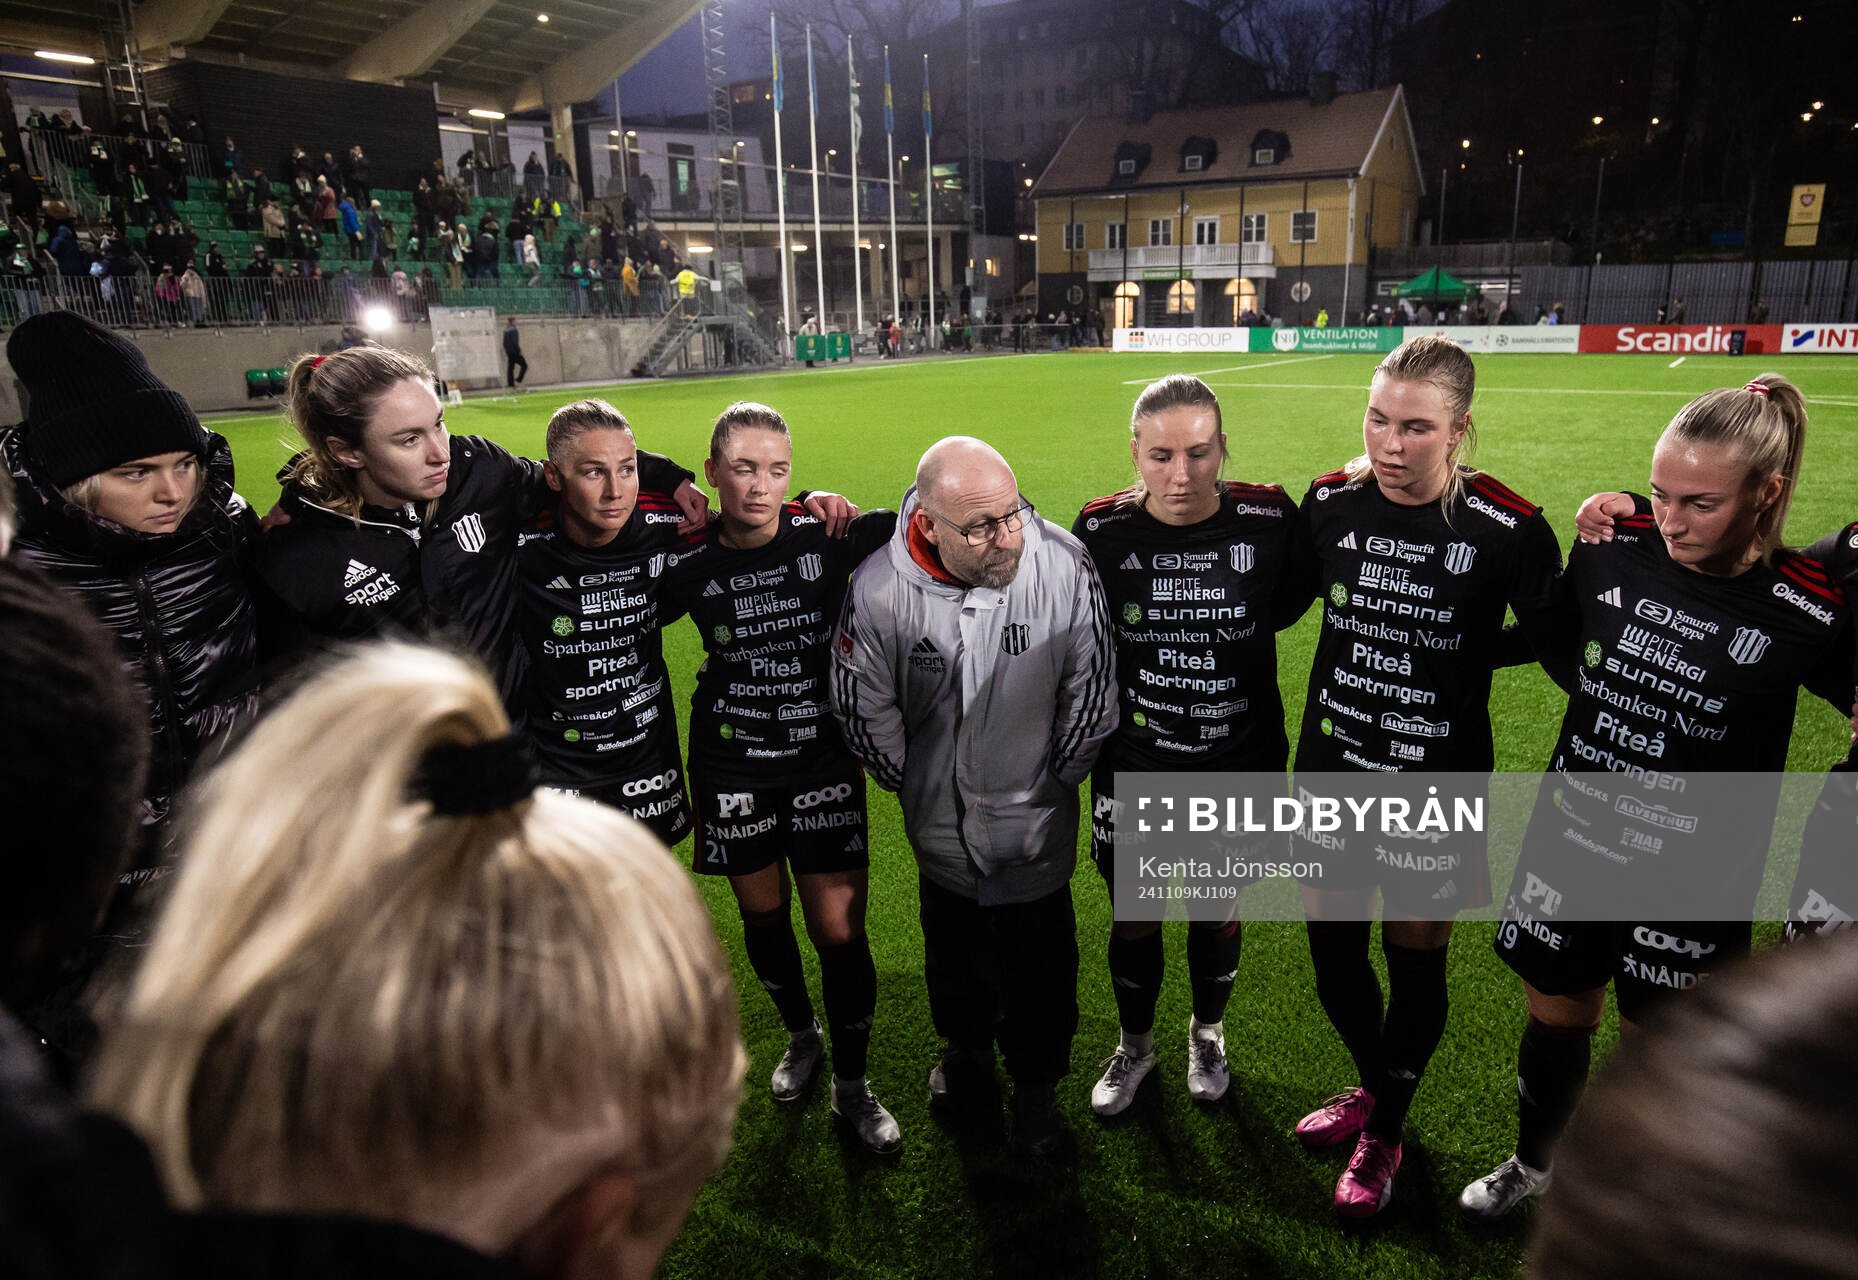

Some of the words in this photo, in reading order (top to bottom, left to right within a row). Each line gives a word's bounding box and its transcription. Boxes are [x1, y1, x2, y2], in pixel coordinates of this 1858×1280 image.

[1148, 333, 1171, 346] WH
[1176, 333, 1231, 347] GROUP
[1303, 329, 1378, 340] VENTILATION
[1616, 326, 1731, 352] Scandic
[1236, 503, 1283, 519] Picknick
[1466, 495, 1518, 530] Picknick
[1183, 552, 1219, 561] Smurfit
[1396, 549, 1426, 563] Kappa
[1397, 540, 1435, 555] Smurfit
[344, 566, 377, 588] adidas
[608, 566, 640, 577] Smurfit
[756, 565, 788, 579] Smurfit
[1183, 561, 1212, 571] Kappa
[1382, 566, 1411, 582] PITE
[345, 572, 396, 605] sport
[608, 575, 635, 583] Kappa
[758, 575, 784, 587] Kappa
[1174, 578, 1200, 589] PITE
[1381, 578, 1434, 599] ENERGI
[365, 584, 400, 607] ringen
[602, 588, 625, 601] PITE
[602, 593, 647, 612] ENERGI
[754, 592, 777, 605] PITE
[1174, 588, 1225, 601] ENERGI
[1772, 582, 1836, 626] Picknick
[755, 597, 801, 617] ENERGI
[1118, 624, 1210, 643] Sparbanken
[1215, 622, 1256, 643] Nord
[1327, 607, 1409, 644] Sparbanken
[1413, 629, 1462, 650] Nord
[1669, 619, 1705, 641] Kappa
[1675, 609, 1720, 635] Smurfit
[544, 634, 635, 658] Sparbanken
[722, 640, 796, 662] arbanken
[1649, 634, 1684, 657] PITE
[588, 648, 639, 678] Piteå
[750, 656, 802, 677] Piteå
[908, 655, 946, 668] sport
[1158, 648, 1216, 671] Piteå
[1352, 642, 1412, 676] Piteå
[1642, 648, 1707, 683] ENERGI
[1138, 695, 1184, 714] LINDBÄCKS
[1193, 702, 1246, 716] ÄLVSBYHUS
[1328, 697, 1373, 723] LINDBÄCKS
[1579, 665, 1667, 723] Sparbanken
[1671, 711, 1728, 741] Nord
[1384, 717, 1446, 735] ÄLVSBYHUS
[1593, 711, 1665, 758] Piteå
[1399, 743, 1425, 758] JIAB
[622, 769, 678, 797] coop
[633, 790, 683, 820] NÅIDEN
[717, 792, 754, 819] PT
[793, 783, 852, 809] coop
[1094, 793, 1126, 825] PT
[1619, 801, 1693, 830] ÄLVSBYHUS
[717, 813, 777, 840] NÅIDEN
[805, 810, 861, 831] NÅIDEN
[1093, 822, 1147, 846] NÅIDEN
[1295, 822, 1345, 851] ÅIDEN
[1632, 832, 1664, 851] JIAB
[705, 840, 728, 865] 21
[1389, 852, 1461, 871] NÅIDEN
[1521, 871, 1562, 916] PT
[1498, 917, 1518, 949] 19
[1515, 906, 1570, 950] NÅIDE
